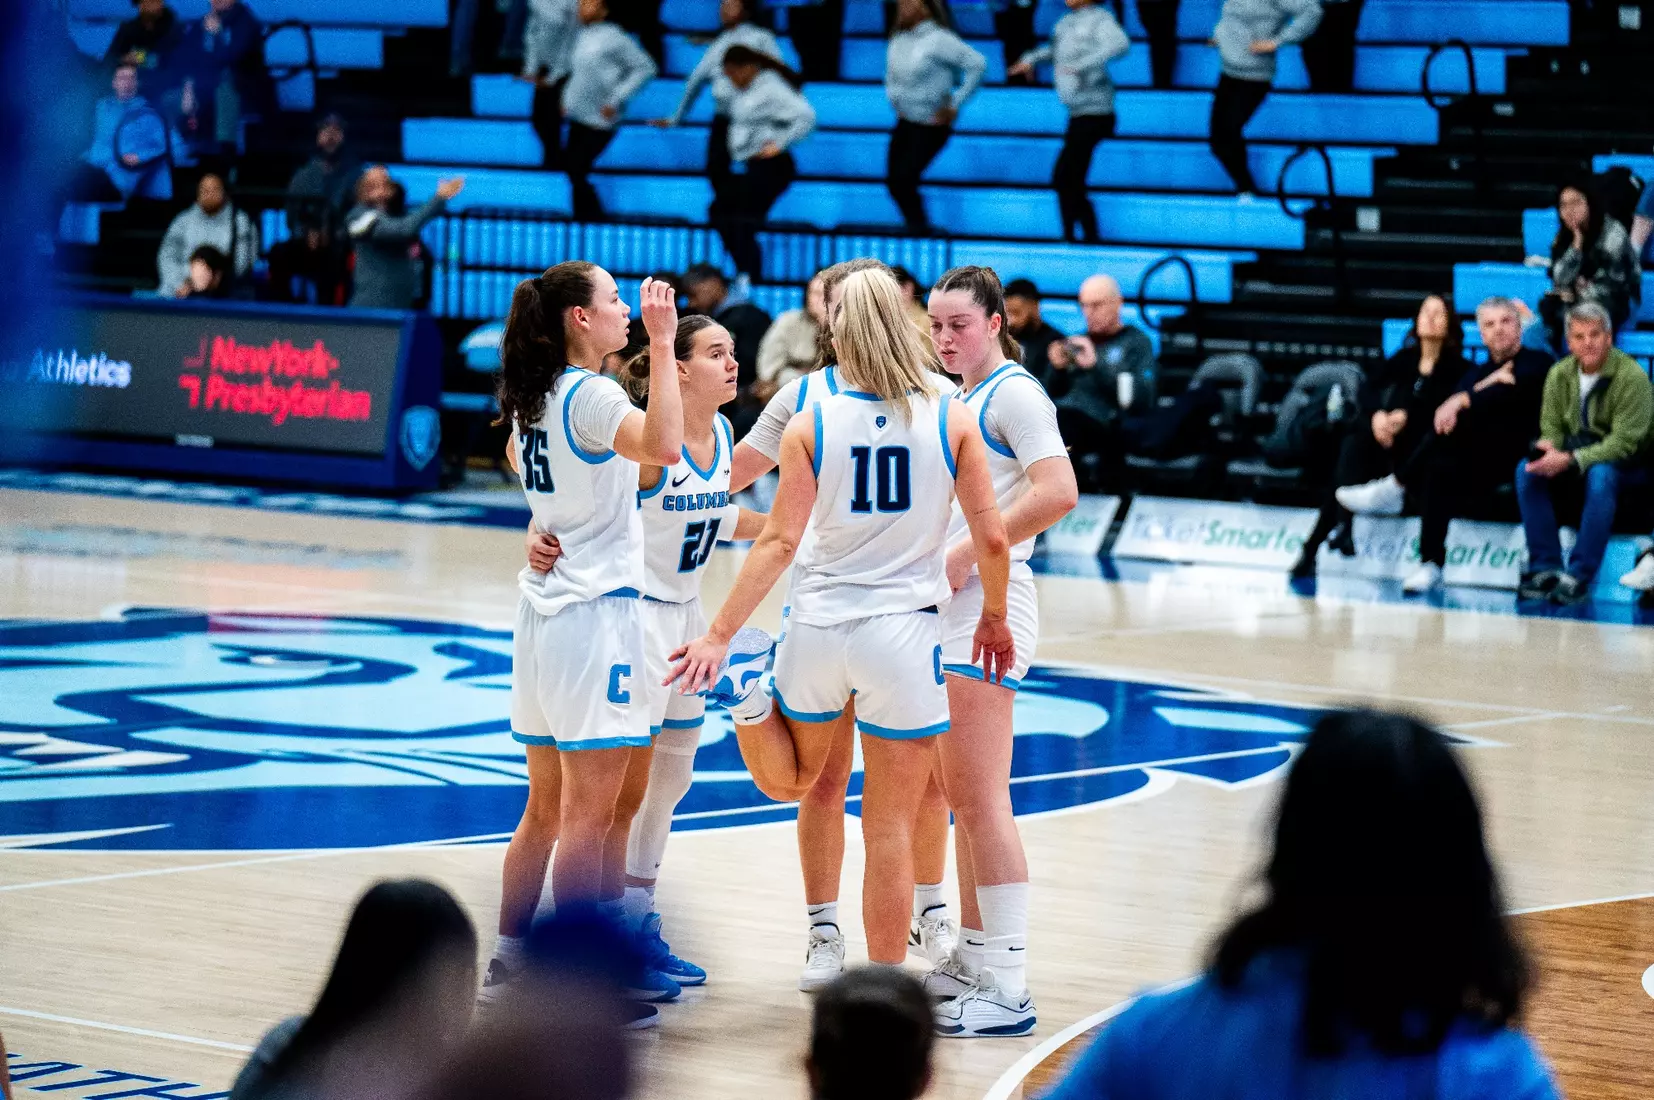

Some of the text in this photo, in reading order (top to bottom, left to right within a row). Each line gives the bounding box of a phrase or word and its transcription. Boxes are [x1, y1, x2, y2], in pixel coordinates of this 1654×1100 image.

[27, 349, 132, 388] Athletics
[205, 373, 371, 427] Presbyterian
[519, 427, 555, 494] 35
[850, 445, 912, 514] 10
[677, 516, 722, 573] 21
[606, 662, 632, 705] C
